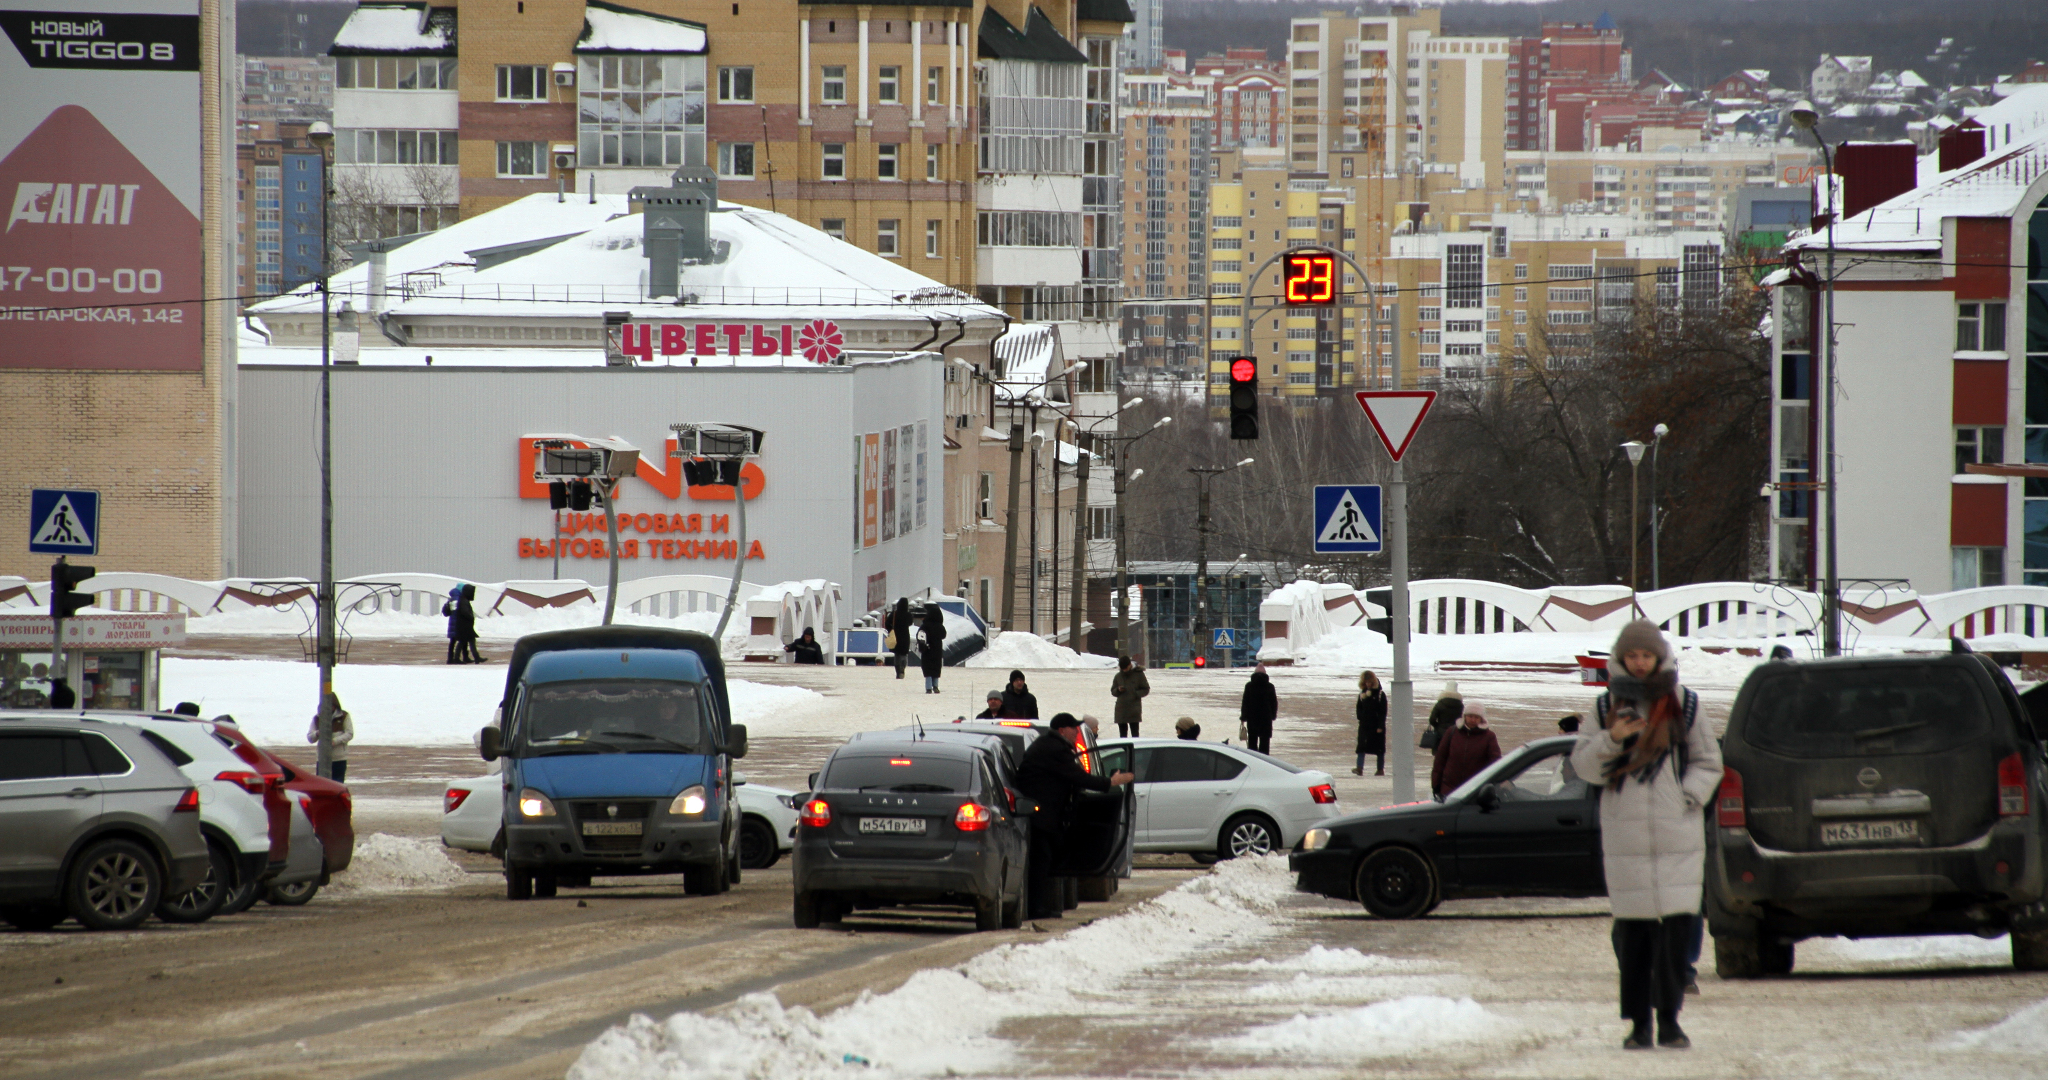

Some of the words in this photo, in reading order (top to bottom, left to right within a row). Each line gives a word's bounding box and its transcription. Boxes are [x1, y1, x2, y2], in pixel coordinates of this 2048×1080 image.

[31, 20, 103, 36] НОВЫЙ
[31, 40, 144, 60] TIGGO
[150, 42, 174, 60] 8
[1783, 165, 1835, 184] СИТ
[1287, 258, 1333, 301] 23
[142, 308, 183, 323] 142
[621, 323, 793, 361] ЦВЕТЫ
[711, 513, 729, 534] И
[111, 621, 146, 630] ТОВАРЫ
[105, 631, 151, 640] МОРДОВИИ
[868, 797, 918, 806] LADA
[863, 819, 908, 831] М541ВУ
[912, 820, 923, 828] 13
[1826, 824, 1893, 841] М631НВ
[1899, 822, 1913, 833] 13
